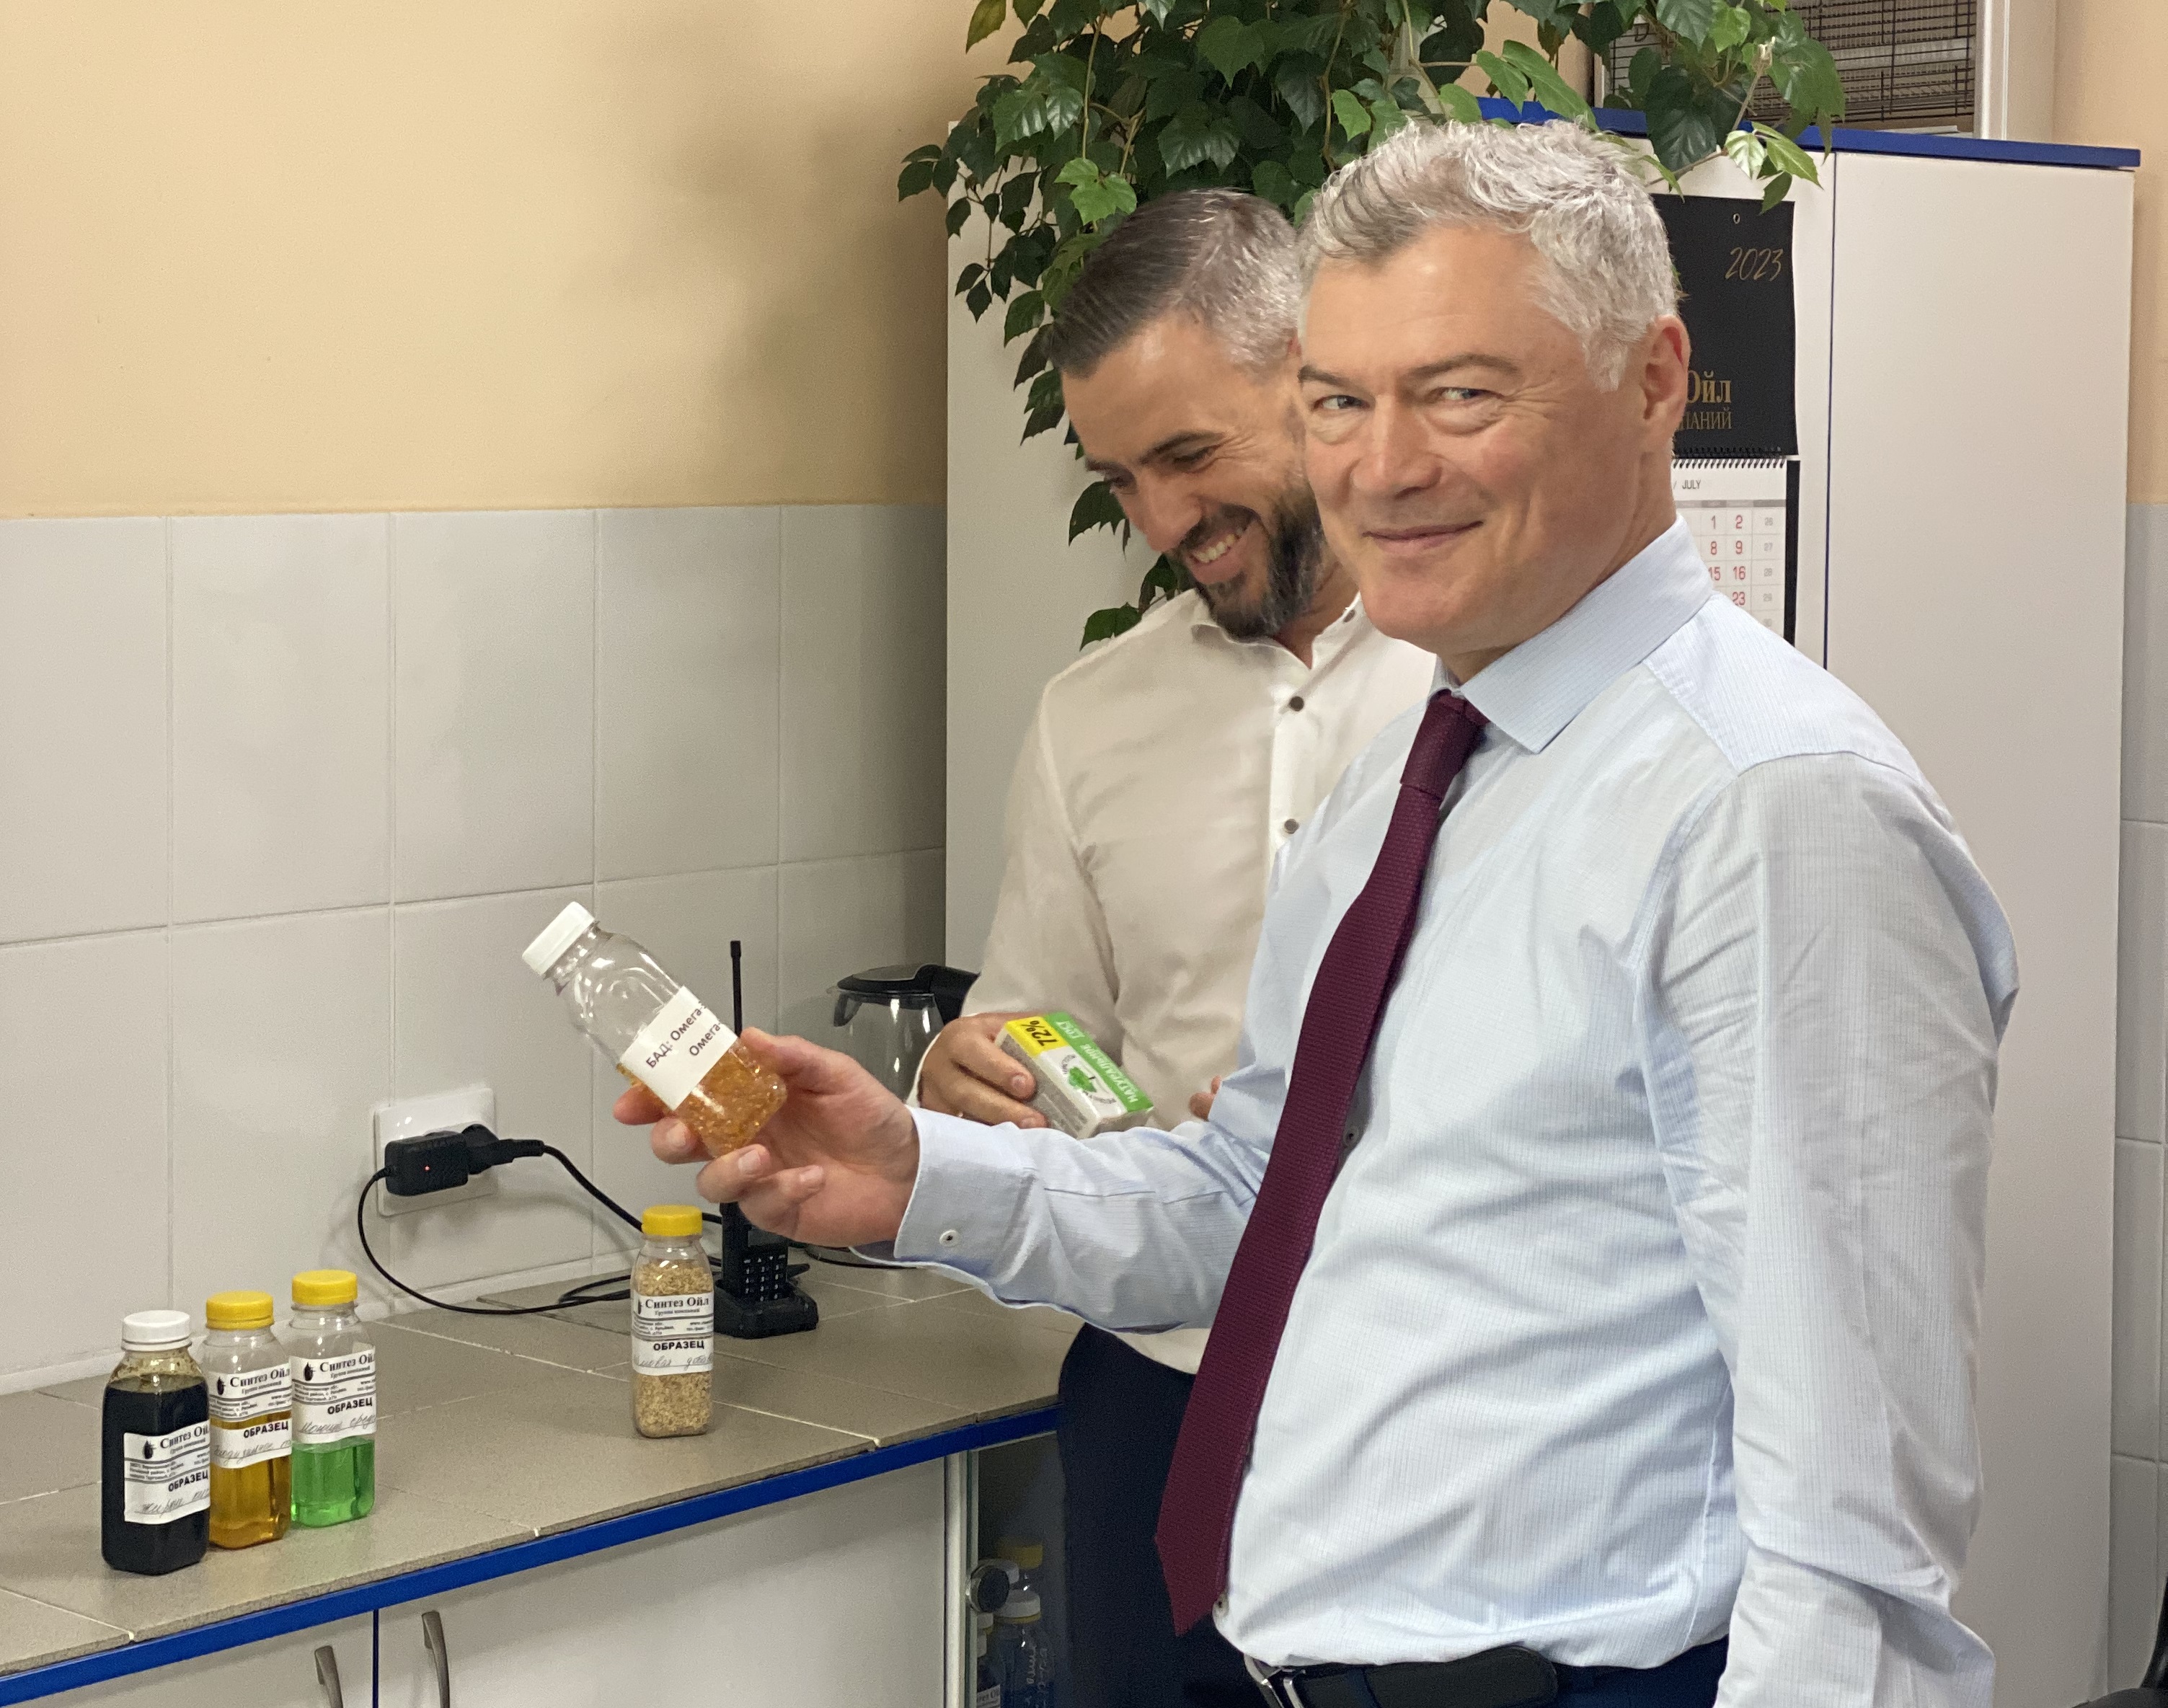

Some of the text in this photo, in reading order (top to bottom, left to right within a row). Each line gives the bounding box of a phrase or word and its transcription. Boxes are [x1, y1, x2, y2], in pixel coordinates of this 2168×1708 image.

[1725, 247, 1784, 282] 2023
[1678, 405, 1732, 430] ПАНИЙ
[1682, 479, 1702, 490] JULY
[1711, 515, 1717, 530] 1
[1735, 514, 1743, 529] 2
[1709, 541, 1717, 555] 8
[1735, 540, 1743, 554] 9
[1708, 566, 1721, 581] 15
[1733, 566, 1746, 580] 16
[1732, 591, 1746, 606] 23
[1022, 1019, 1058, 1046] 72%
[646, 1040, 673, 1068] БАД:
[645, 1297, 709, 1309] Синтез Ойл
[653, 1340, 704, 1351] ОБРАЗЕЦ
[319, 1358, 356, 1372] Синтез
[230, 1373, 267, 1387] Синтез
[327, 1397, 373, 1415] ОБРАЗЕЦ
[243, 1421, 288, 1438] ОБРАЗЕЦ
[159, 1431, 192, 1448] Синтез
[168, 1470, 208, 1492] ОБРАЗЕЦ
